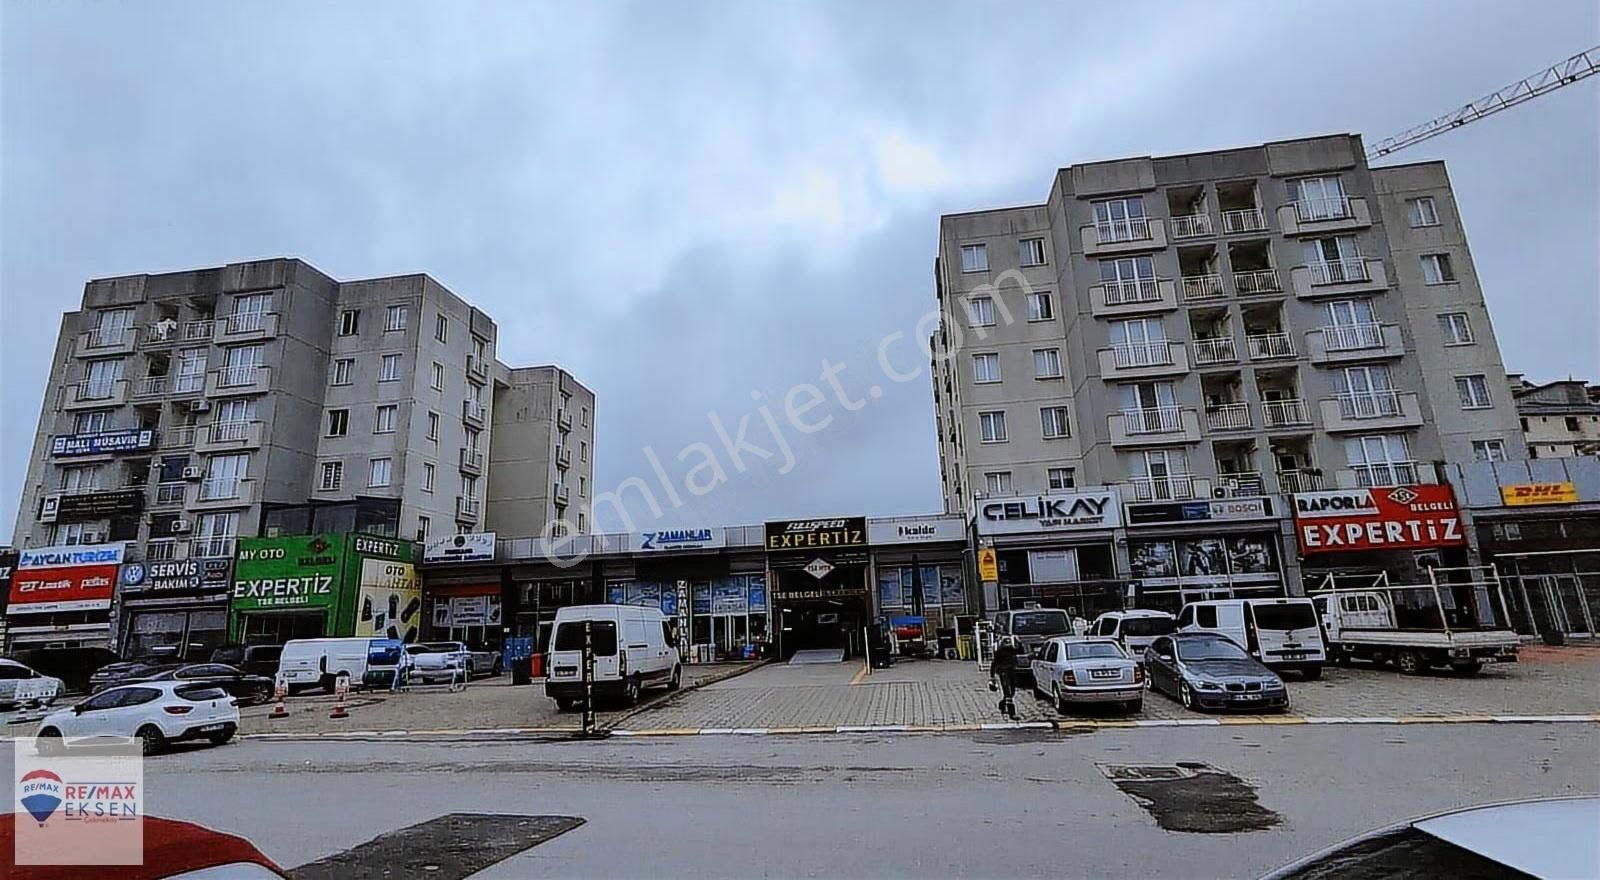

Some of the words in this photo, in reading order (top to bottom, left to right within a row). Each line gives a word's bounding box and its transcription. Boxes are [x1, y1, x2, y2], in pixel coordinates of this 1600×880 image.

[1514, 485, 1561, 497] DHL
[1228, 504, 1261, 513] BOSCH
[1299, 495, 1376, 512] RAPORLA
[1063, 516, 1105, 525] MARKET
[657, 529, 712, 541] ZAMANLAR
[770, 527, 862, 548] EXPERTİZ
[1303, 518, 1462, 547] EXPERTİZ
[240, 550, 257, 560] MY
[260, 548, 285, 559] OTO
[150, 560, 197, 577] SERVİS
[385, 565, 405, 576] OTO
[154, 579, 188, 590] BAKIM
[234, 572, 332, 598] EXPERTİZ
